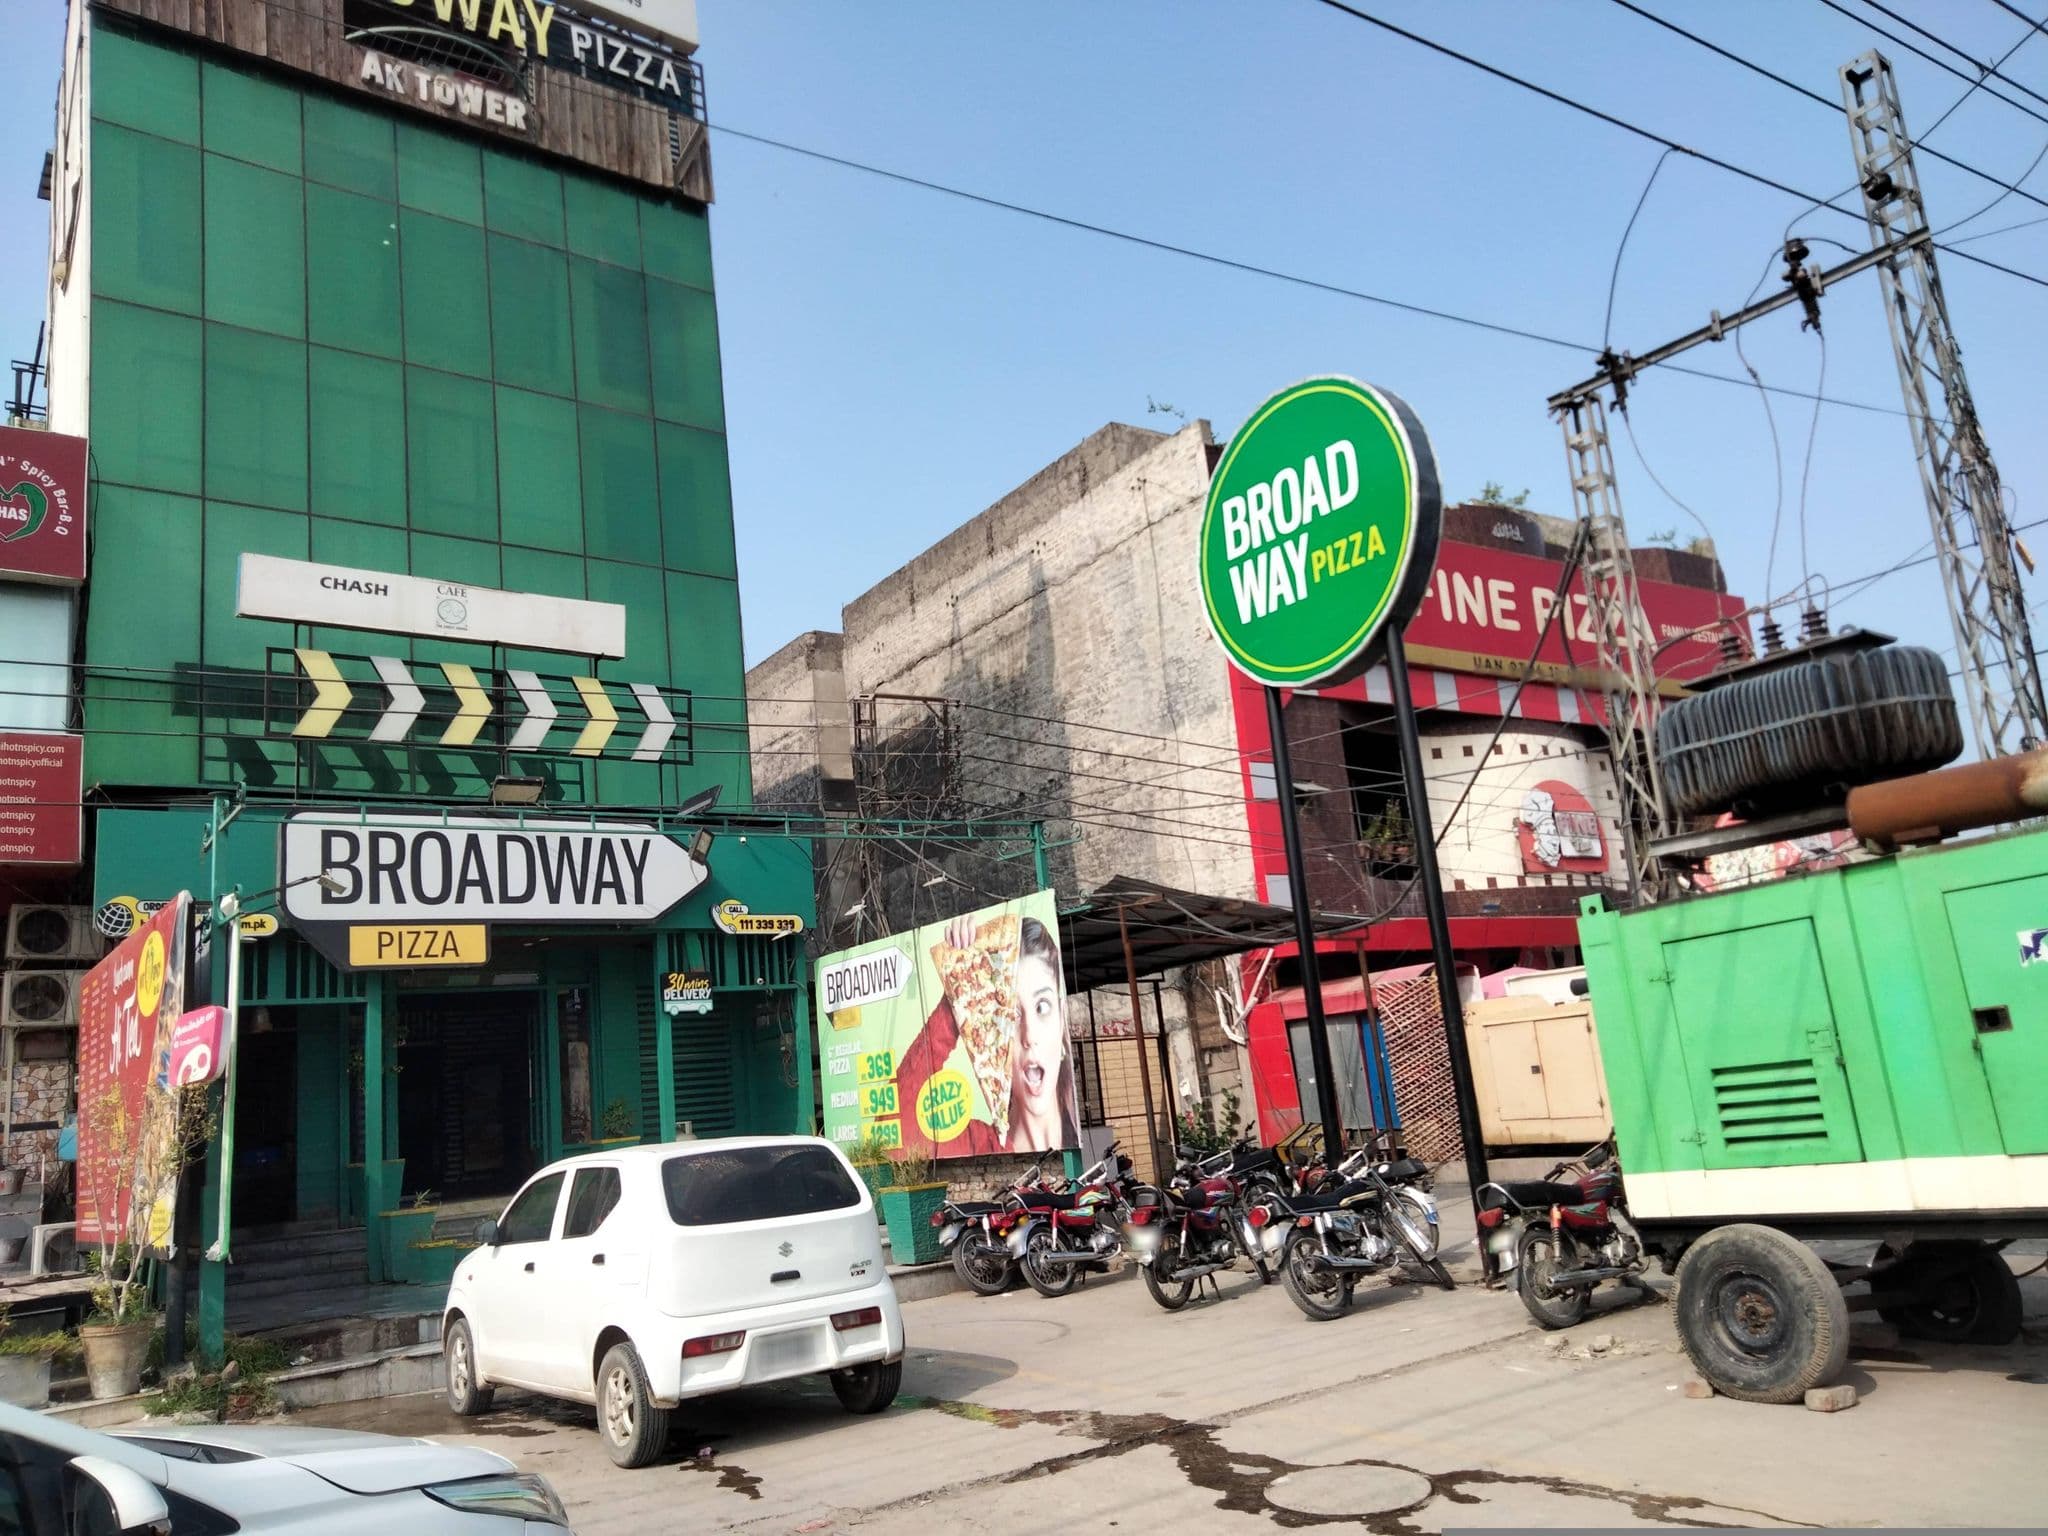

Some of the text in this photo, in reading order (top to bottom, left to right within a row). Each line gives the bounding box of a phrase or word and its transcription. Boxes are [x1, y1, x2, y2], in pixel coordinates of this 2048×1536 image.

[570, 23, 682, 97] PIZZA
[361, 50, 528, 131] AK TOWER
[20, 460, 57, 488] Spicy
[1222, 439, 1360, 561] BROAD
[320, 576, 389, 597] CHASH
[1229, 524, 1386, 625] WAY PIZZA
[437, 585, 468, 598] CAFE
[1532, 586, 1658, 654] PIZZA
[1473, 656, 1503, 670] UAN
[321, 829, 651, 905] BROADWAY
[728, 906, 744, 914] CALL
[739, 920, 795, 930] 111 339 339
[377, 930, 460, 960] PIZZA
[663, 987, 712, 1000] DELIVERY
[668, 973, 710, 991] 30 mins
[826, 954, 899, 1005] BROADWAY
[829, 1052, 893, 1079] PIZZA 369
[831, 1087, 895, 1114] MEDIUM 949
[923, 1081, 962, 1112] CRAZY
[925, 1099, 967, 1131] VALUE
[832, 1125, 858, 1143] LARGE
